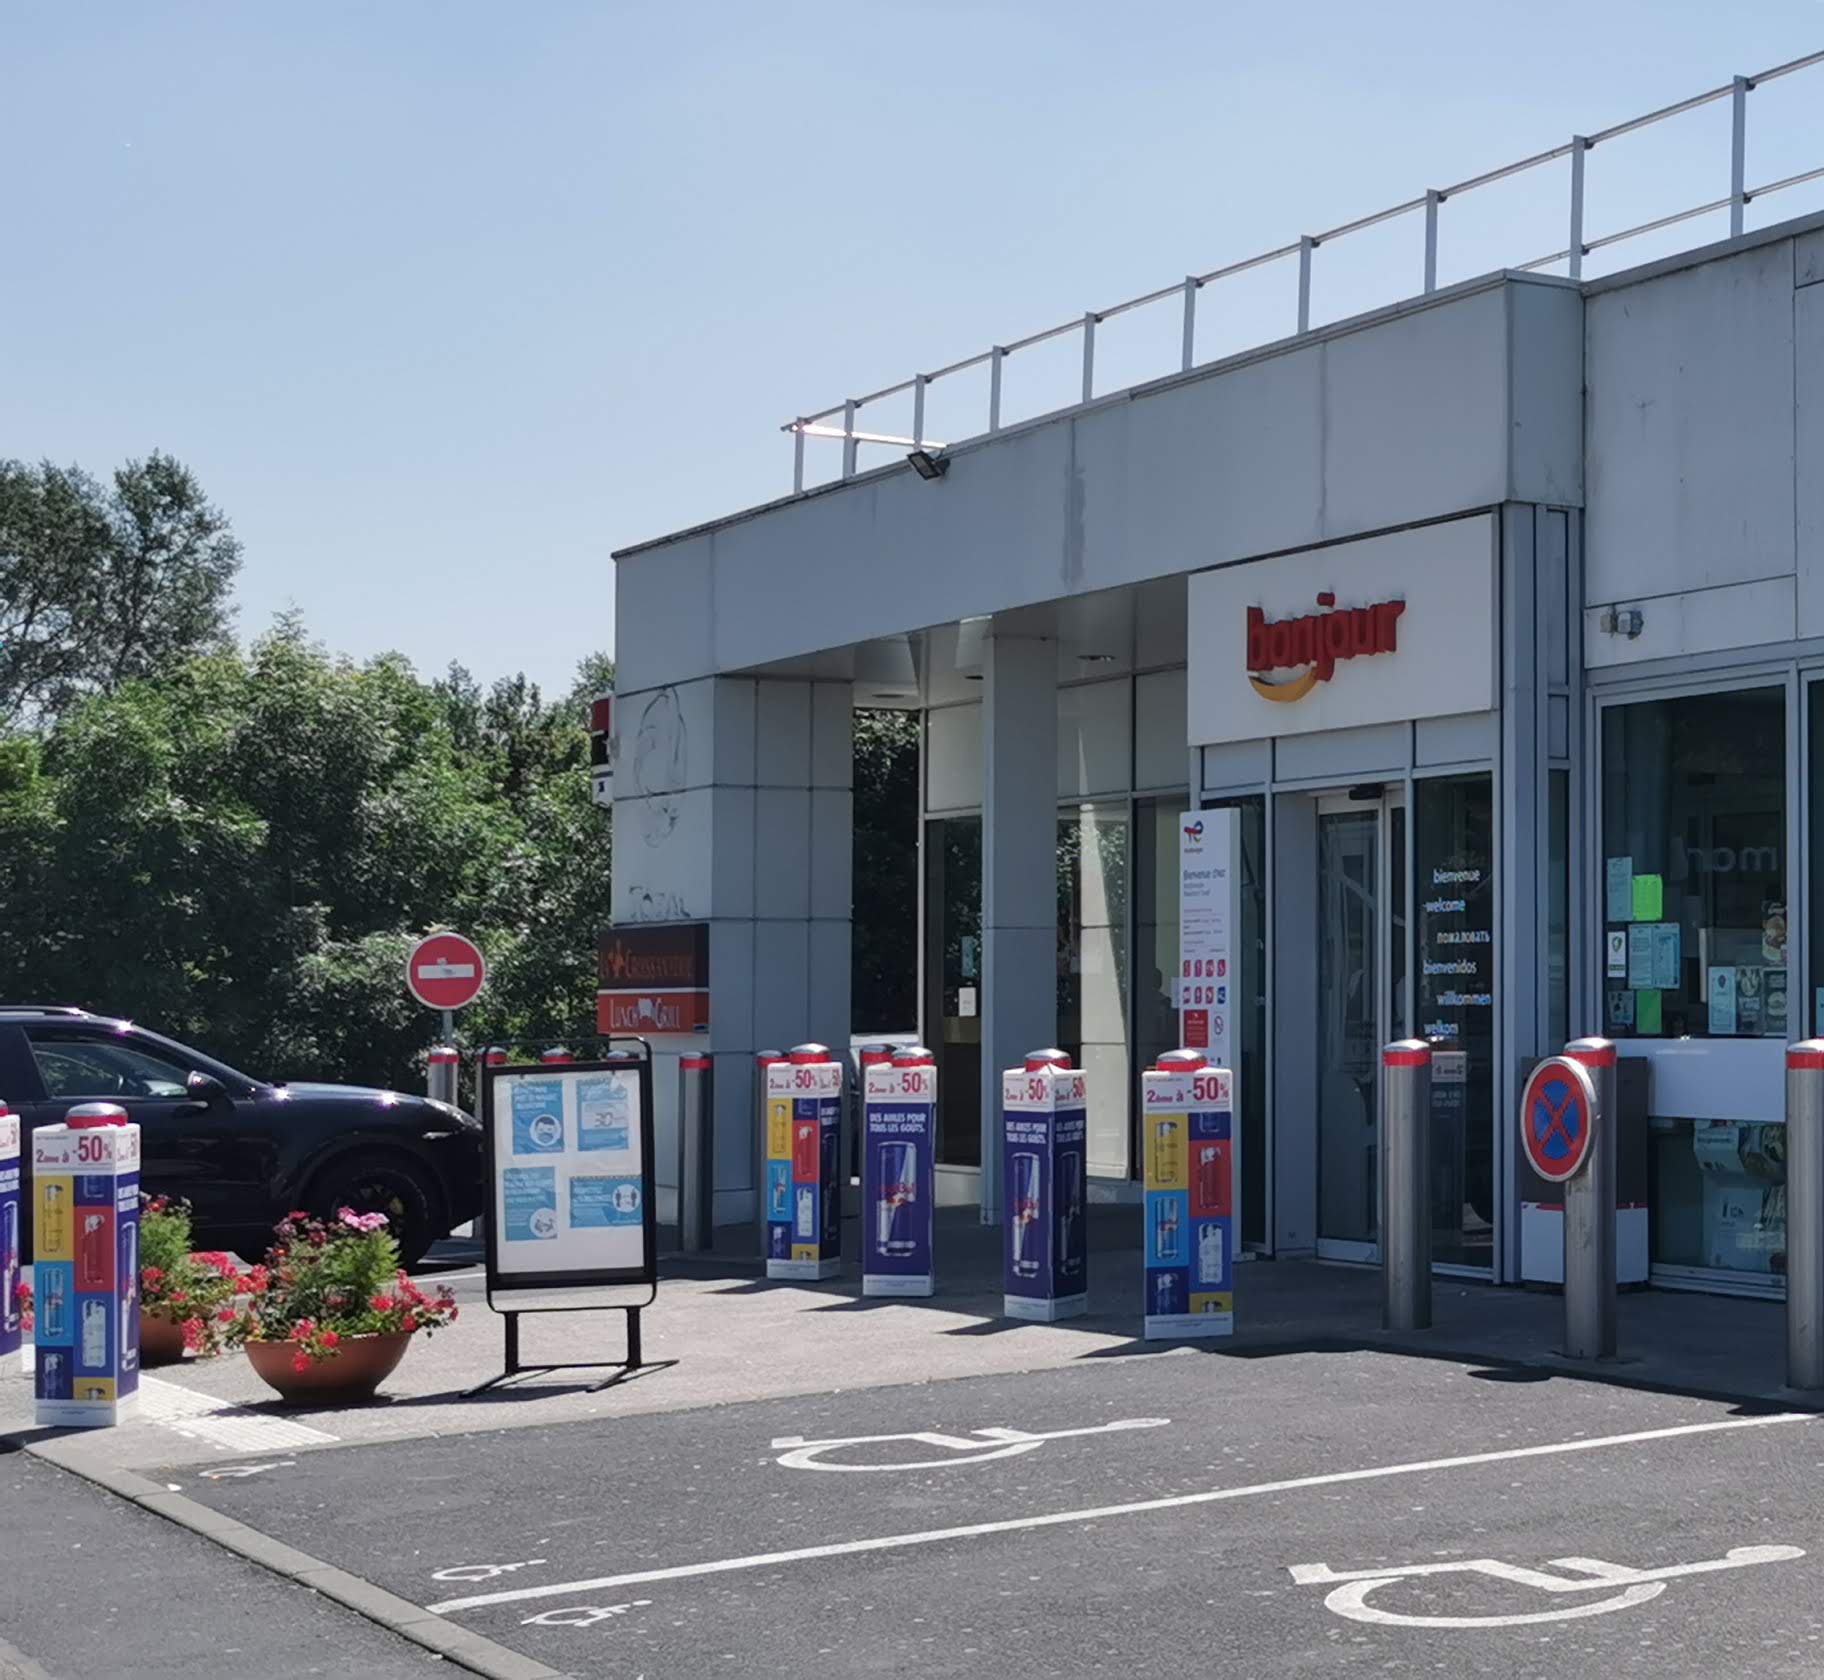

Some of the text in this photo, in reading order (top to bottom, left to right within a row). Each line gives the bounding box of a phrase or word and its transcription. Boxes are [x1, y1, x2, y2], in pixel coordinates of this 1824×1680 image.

[1246, 591, 1407, 683] bonjour
[1433, 869, 1480, 884] bienvenue
[1425, 897, 1466, 912] welcome
[1423, 959, 1477, 975] bienvenidos
